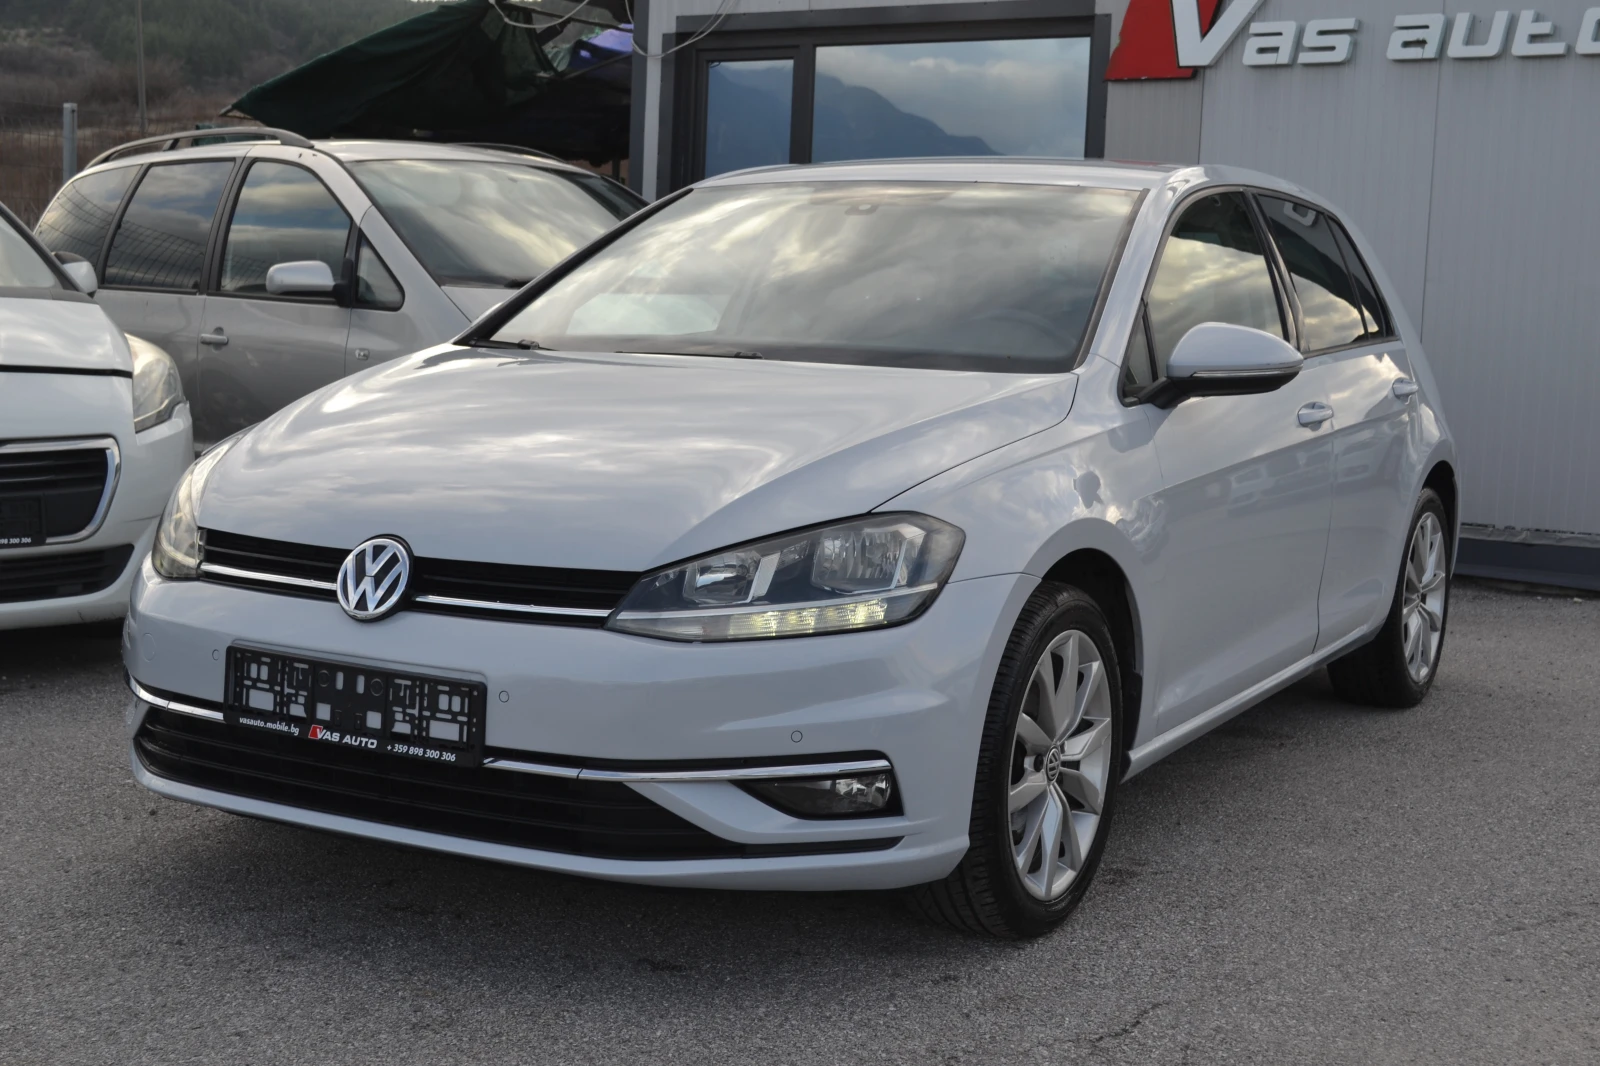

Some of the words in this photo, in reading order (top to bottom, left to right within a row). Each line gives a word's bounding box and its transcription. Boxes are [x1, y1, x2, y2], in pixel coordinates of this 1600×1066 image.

[1172, 0, 1361, 68] Vas
[239, 717, 299, 735] vasauto.mobile.bg
[316, 728, 340, 741] VAS
[342, 735, 377, 748] AUTO
[393, 743, 408, 753] 359
[408, 746, 424, 756] 898
[424, 749, 440, 759] 300
[440, 751, 456, 762] 306
